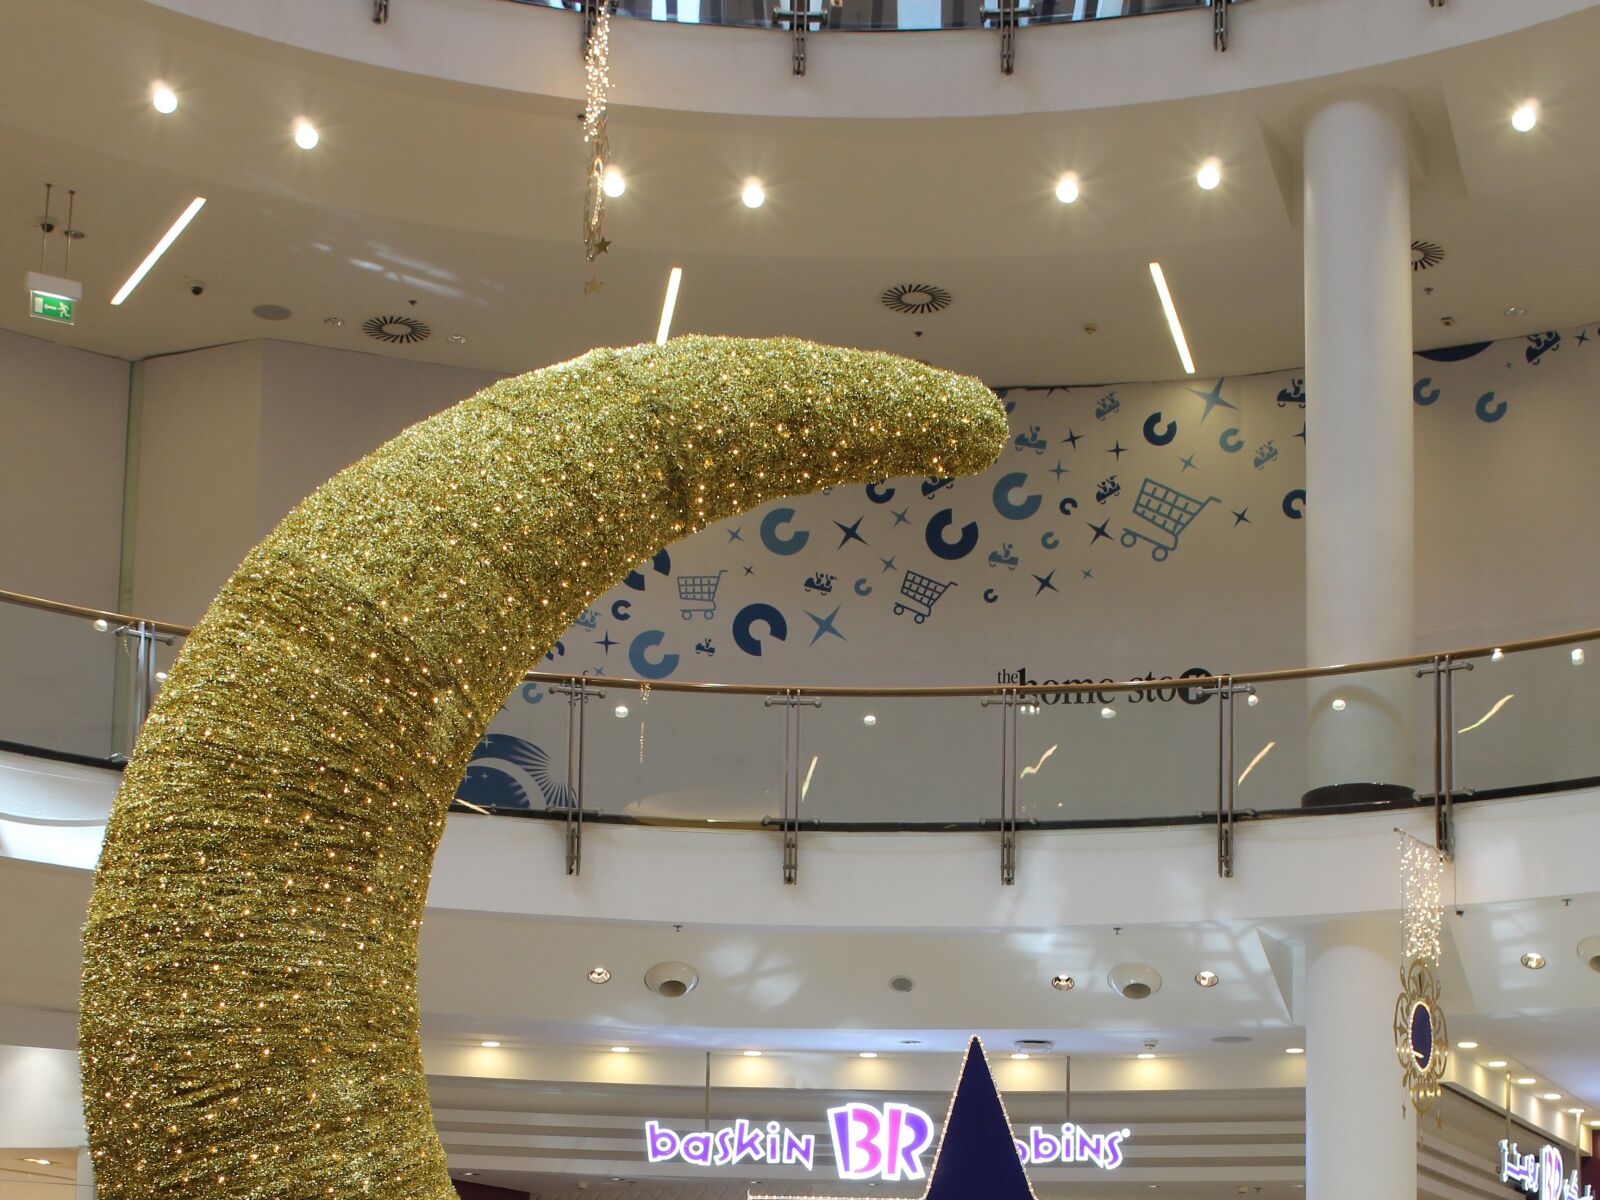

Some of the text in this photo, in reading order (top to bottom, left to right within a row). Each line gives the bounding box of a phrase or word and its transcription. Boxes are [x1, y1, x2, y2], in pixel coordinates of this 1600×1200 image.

[997, 668, 1019, 684] the
[827, 1102, 934, 1181] BR
[1014, 1122, 1123, 1170] bins
